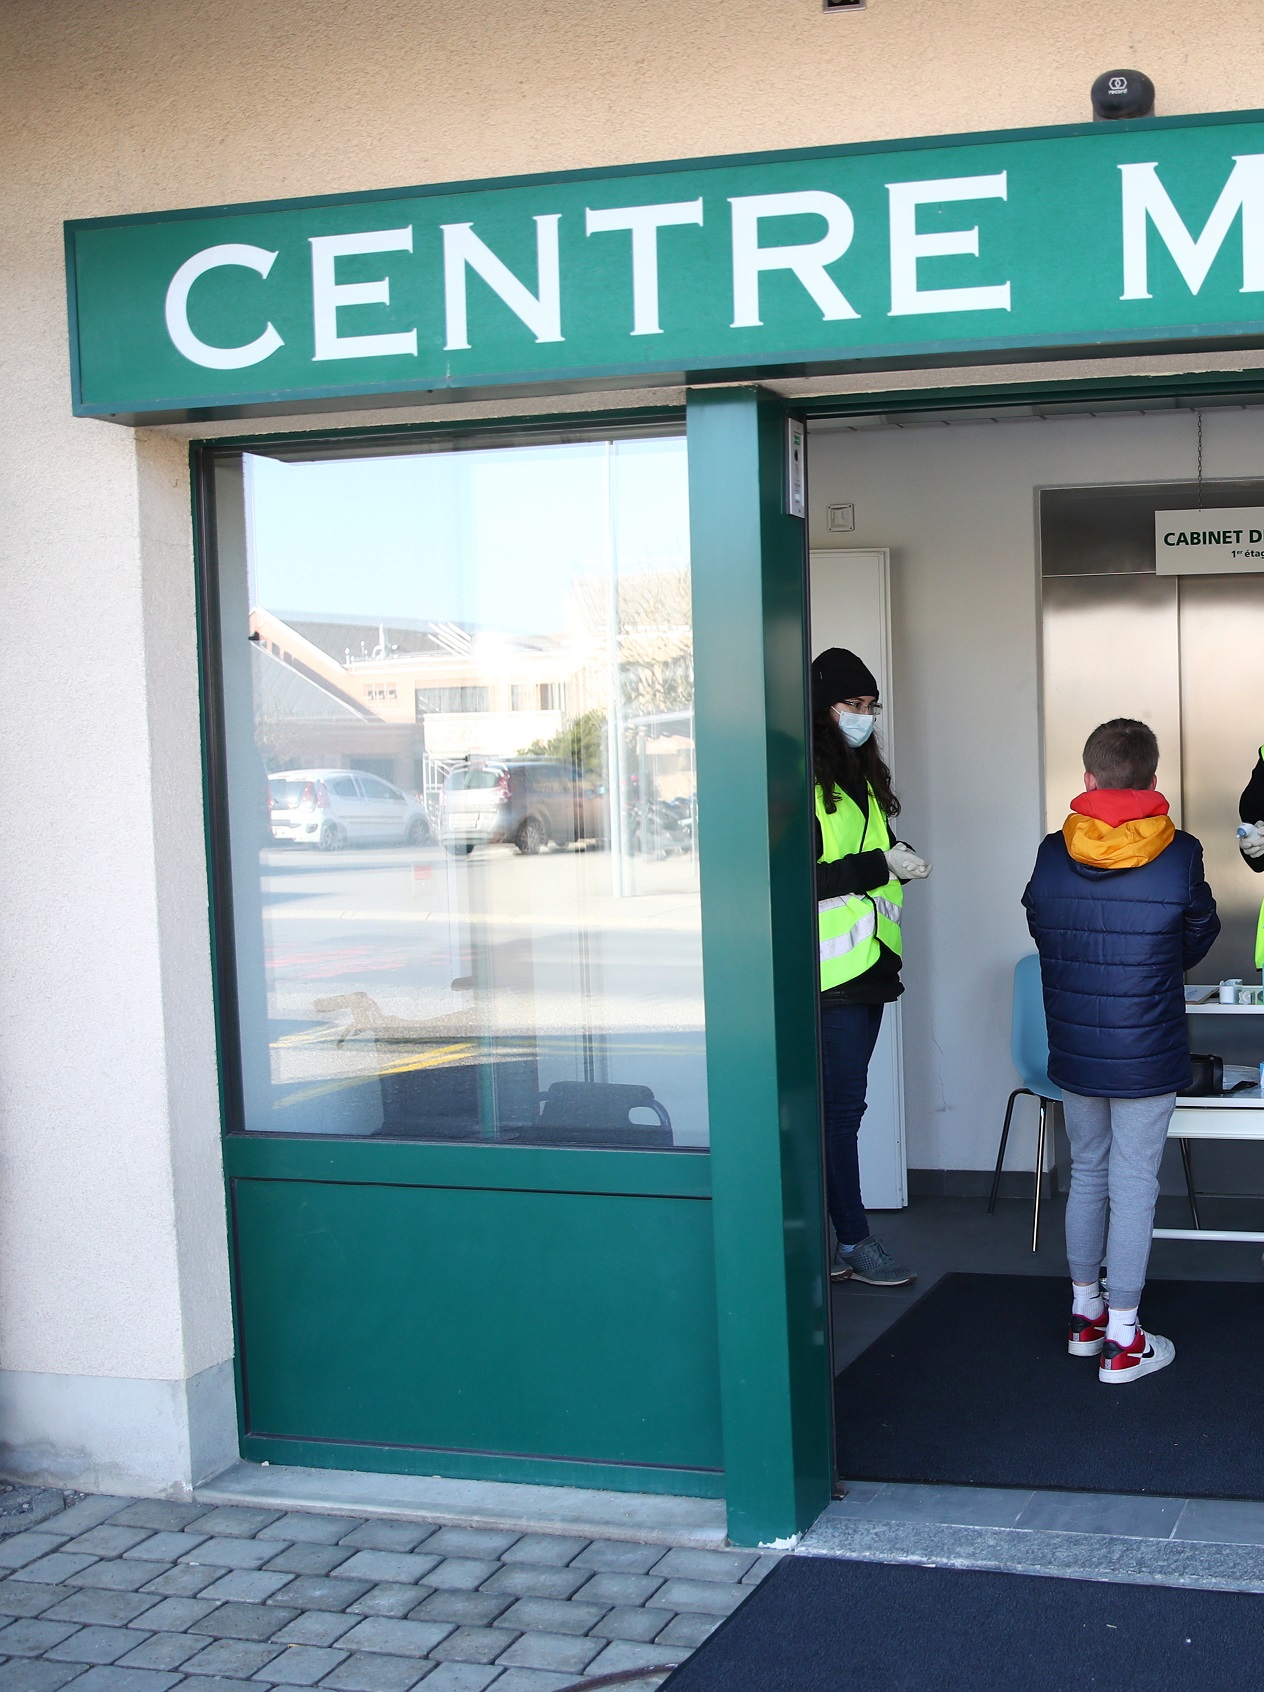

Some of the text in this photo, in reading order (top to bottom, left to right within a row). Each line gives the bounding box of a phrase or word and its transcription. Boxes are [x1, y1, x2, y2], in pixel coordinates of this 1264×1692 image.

[164, 171, 1012, 371] CENTRE
[1163, 529, 1244, 547] CABINET
[1231, 550, 1243, 558] 1er
